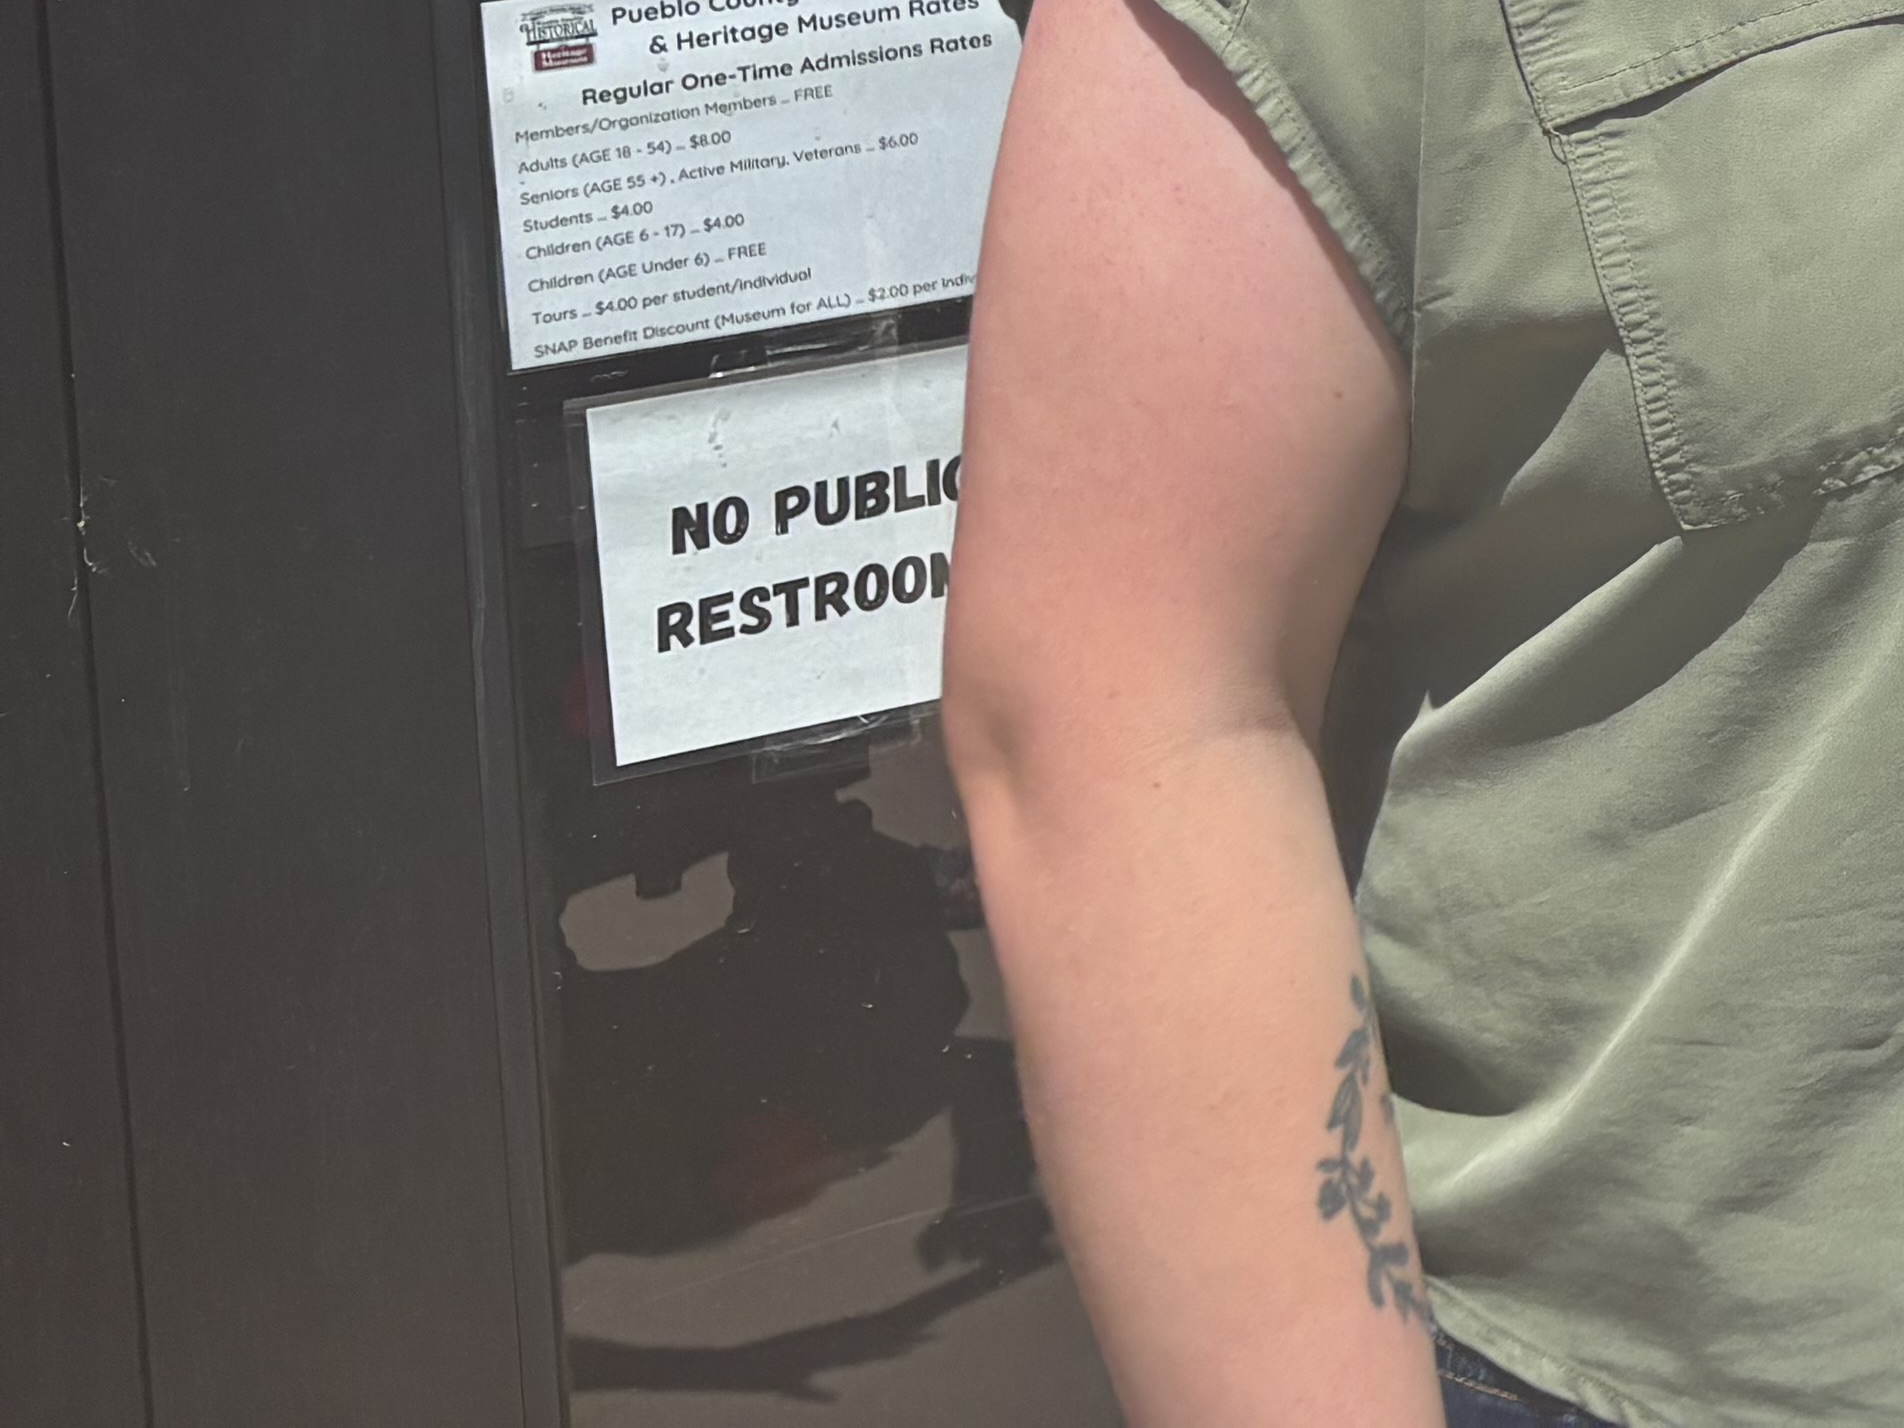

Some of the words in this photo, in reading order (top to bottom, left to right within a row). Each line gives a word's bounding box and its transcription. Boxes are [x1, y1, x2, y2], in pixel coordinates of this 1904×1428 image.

[649, 34, 668, 54] &
[676, 21, 789, 51] Heritage
[797, 5, 900, 33] Museum
[582, 79, 674, 105] Regular
[681, 62, 793, 90] One-Time
[800, 43, 923, 74] Admissions
[929, 33, 992, 55] Rates
[515, 107, 700, 143] Members/Organization
[704, 93, 777, 115] Members
[794, 84, 833, 102] FREE
[518, 157, 568, 174] Adults
[571, 148, 612, 168] (AGE
[616, 145, 632, 159] 18
[647, 139, 672, 155] 54)
[520, 186, 579, 205] Seniors
[583, 178, 622, 198] (AGE
[627, 174, 646, 189] 55
[677, 163, 725, 182] Active
[793, 144, 862, 163] Veterans
[878, 132, 919, 151] $6.00
[523, 212, 593, 233] Students
[611, 200, 653, 220] $4.00
[525, 239, 592, 260] Children
[596, 230, 635, 251] (AGE
[639, 227, 650, 242] 6
[664, 223, 686, 238] 17)
[703, 213, 745, 233] $4.00
[528, 272, 594, 293] Children
[599, 263, 638, 284] (AGE
[642, 257, 689, 274] Under
[694, 252, 710, 267] 6)
[728, 243, 768, 261] FREE
[532, 307, 578, 325] Tours
[595, 296, 638, 316] $4.00
[642, 294, 669, 310] per
[673, 267, 812, 303] student/individual
[534, 340, 578, 359] SNAP
[582, 330, 638, 350] Benefit
[643, 318, 710, 339] Discount
[714, 306, 786, 331] (Museum
[790, 301, 812, 316] for
[816, 293, 852, 310] ALL)
[913, 280, 938, 296] per
[671, 495, 750, 555] NO
